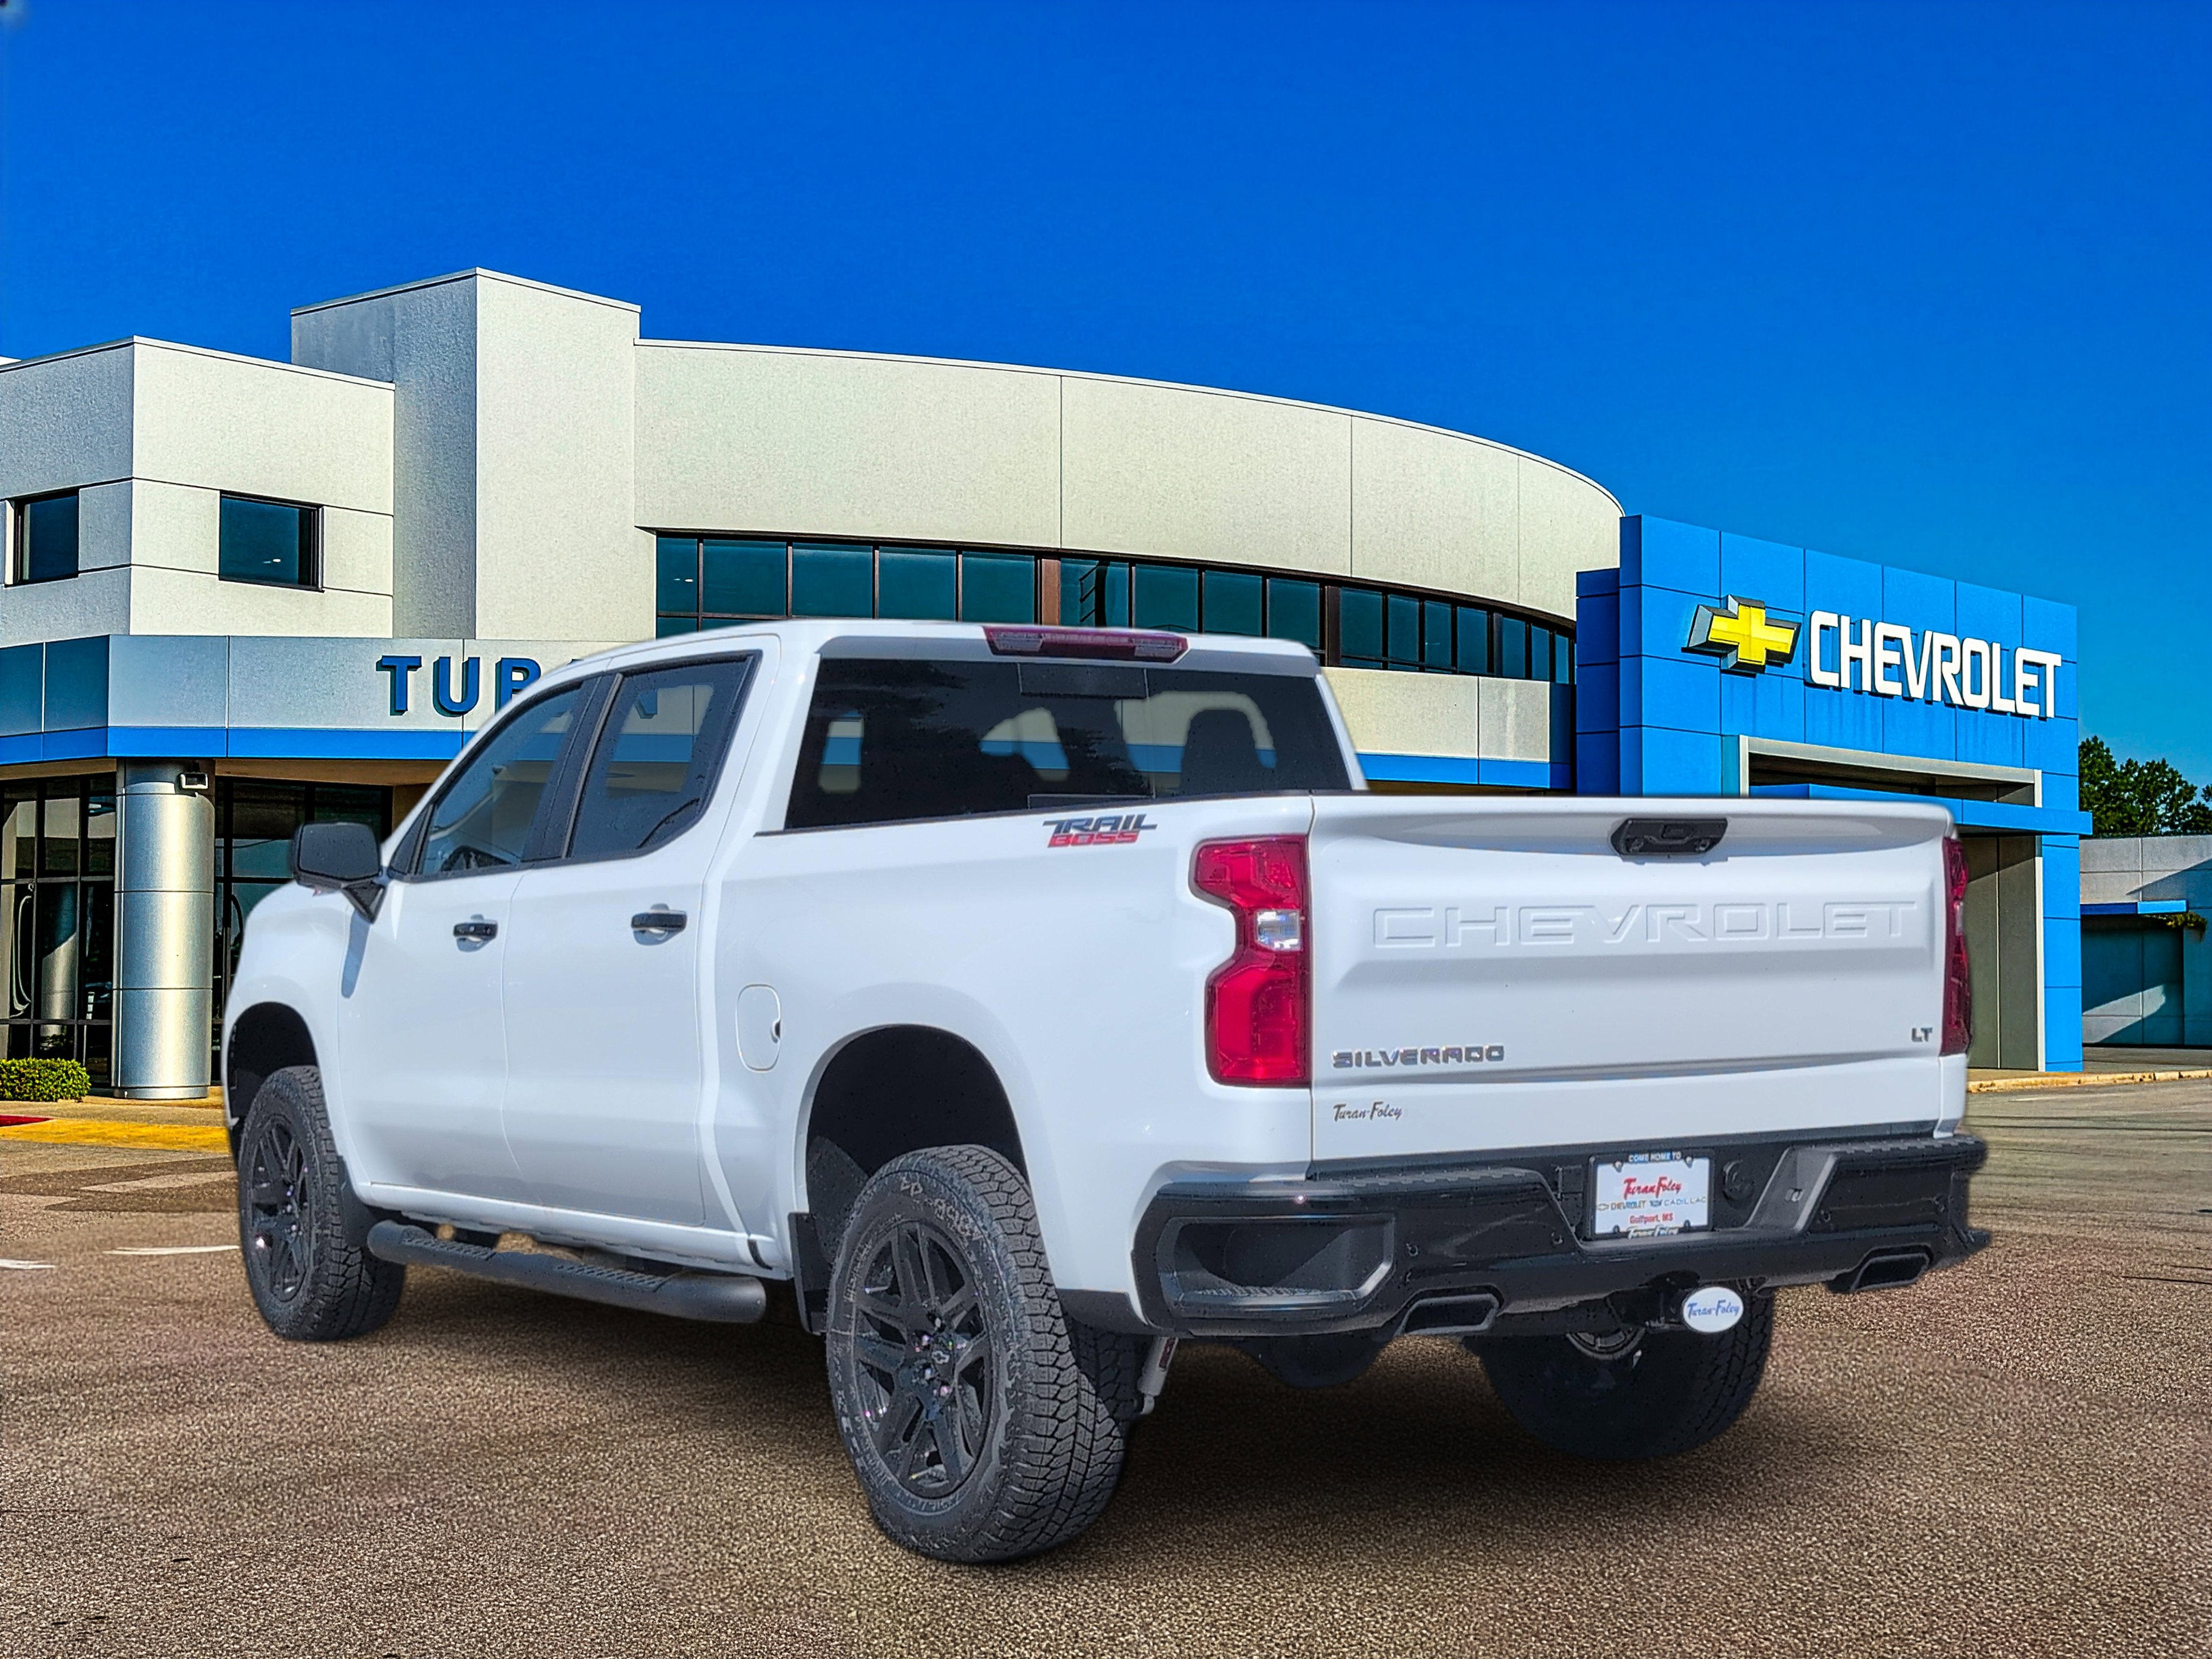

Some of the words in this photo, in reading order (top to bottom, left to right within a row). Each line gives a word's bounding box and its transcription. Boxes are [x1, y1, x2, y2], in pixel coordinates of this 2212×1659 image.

[1807, 610, 2062, 718] CHEVROLET
[1043, 814, 1158, 833] TRAIL
[1047, 831, 1140, 847] BOSS
[1373, 901, 1917, 947] CHEVROLET
[1911, 1027, 1933, 1042] LT
[1332, 1045, 1504, 1068] SILVERADO
[1664, 1197, 1706, 1206] CADILLAC
